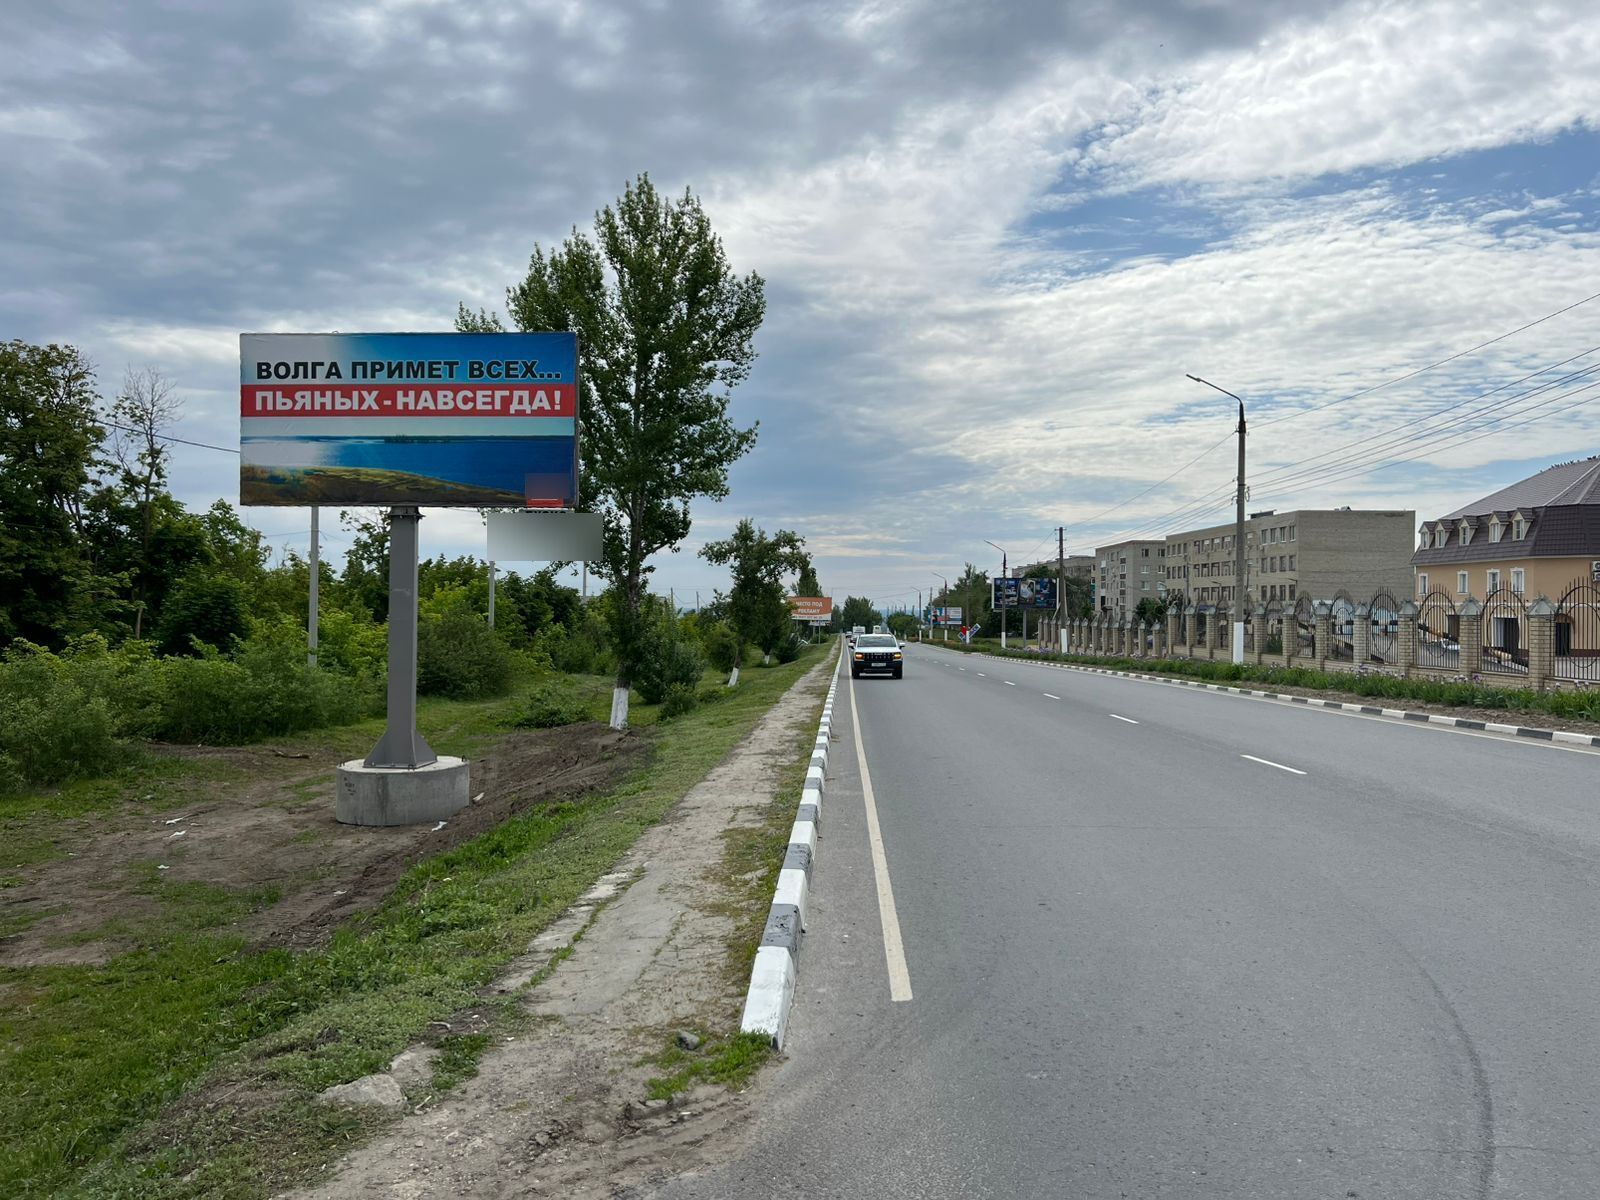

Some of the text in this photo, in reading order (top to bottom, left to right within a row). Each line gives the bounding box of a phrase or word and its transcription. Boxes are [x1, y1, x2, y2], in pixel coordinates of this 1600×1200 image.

[256, 360, 561, 380] ВОЛГА ПРИМЕТ ВСЕХ...
